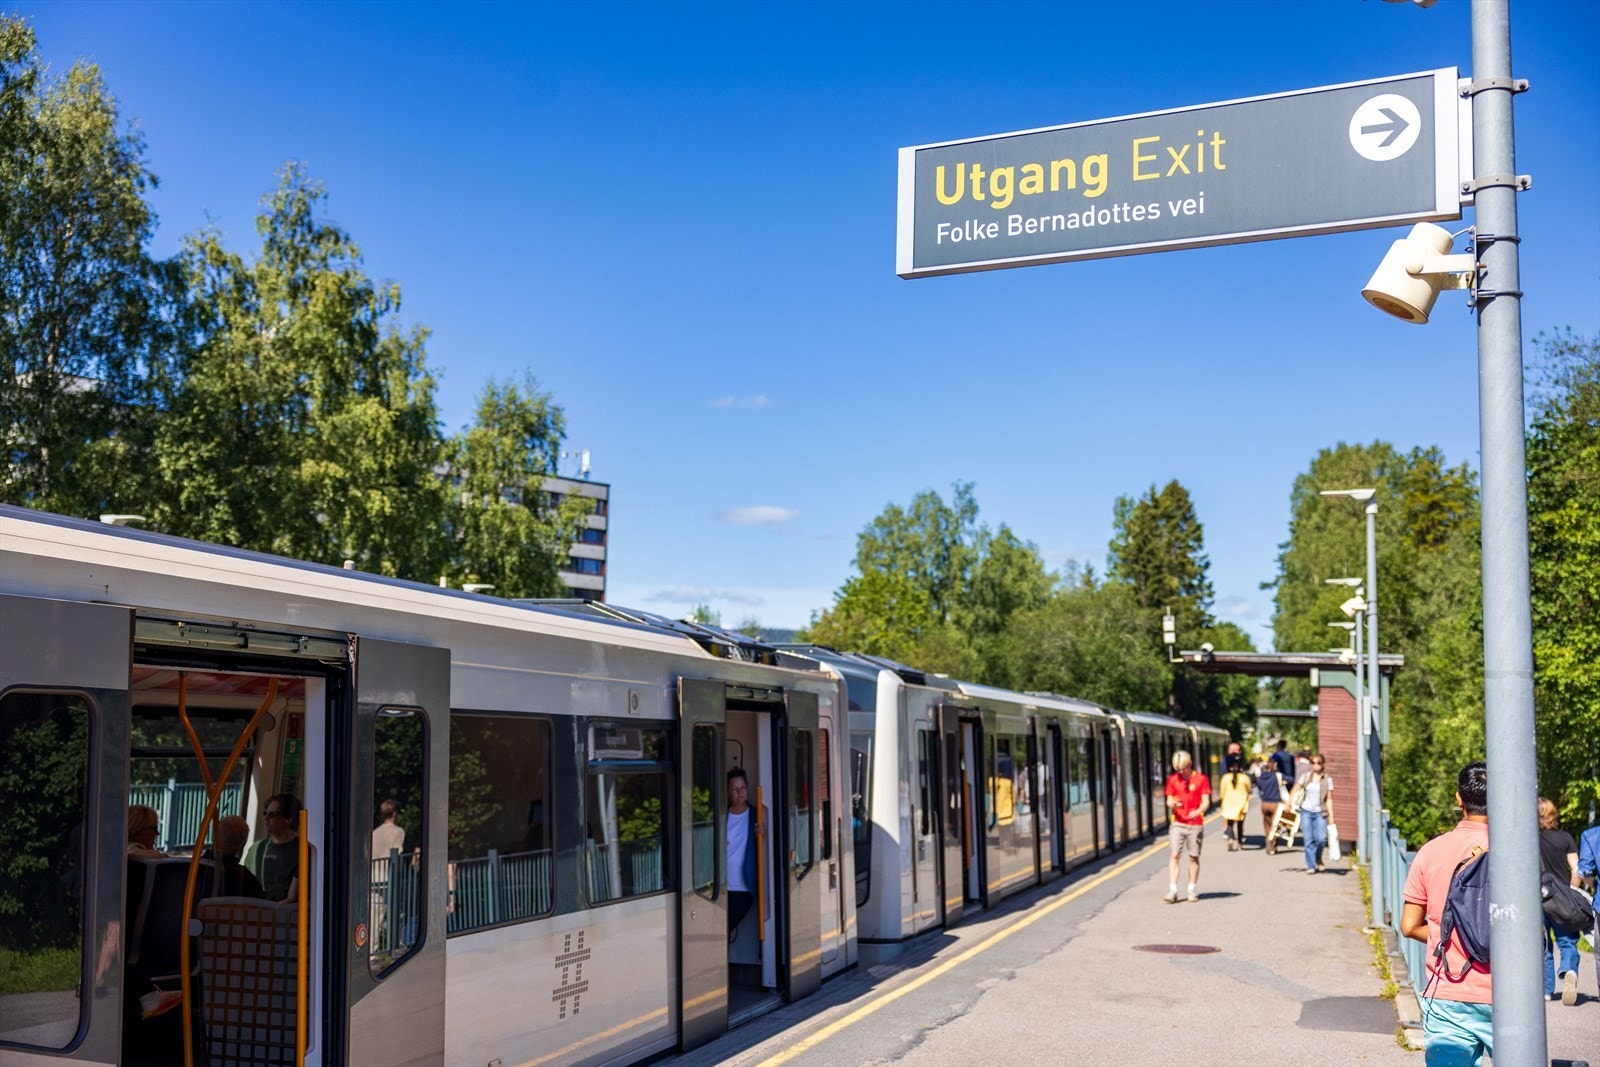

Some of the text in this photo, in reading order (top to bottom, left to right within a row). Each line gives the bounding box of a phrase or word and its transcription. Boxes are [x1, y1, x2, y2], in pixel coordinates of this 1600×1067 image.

[935, 130, 1226, 209] Utgang Exit
[936, 190, 1205, 244] Folke Bernadottes vei
